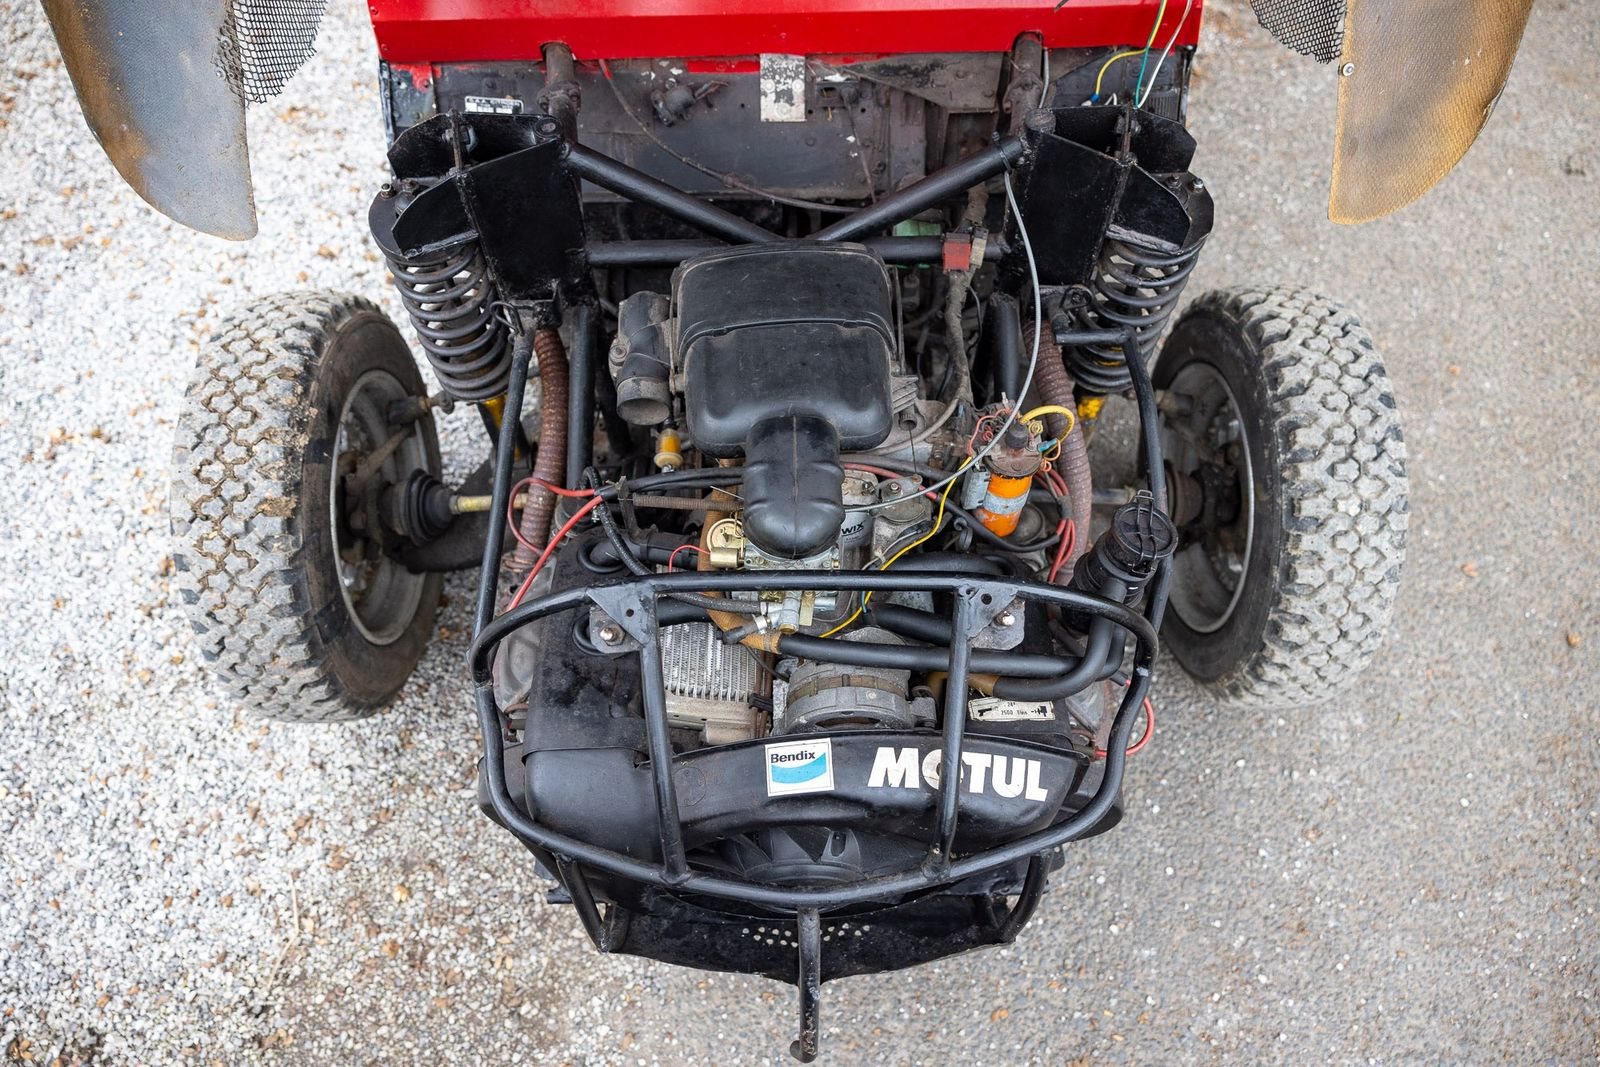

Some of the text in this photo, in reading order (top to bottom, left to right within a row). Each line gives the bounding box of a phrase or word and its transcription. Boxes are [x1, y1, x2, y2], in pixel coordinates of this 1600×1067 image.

[841, 522, 864, 534] WIX
[770, 750, 816, 764] Bendix
[867, 746, 1049, 802] MOTUL
